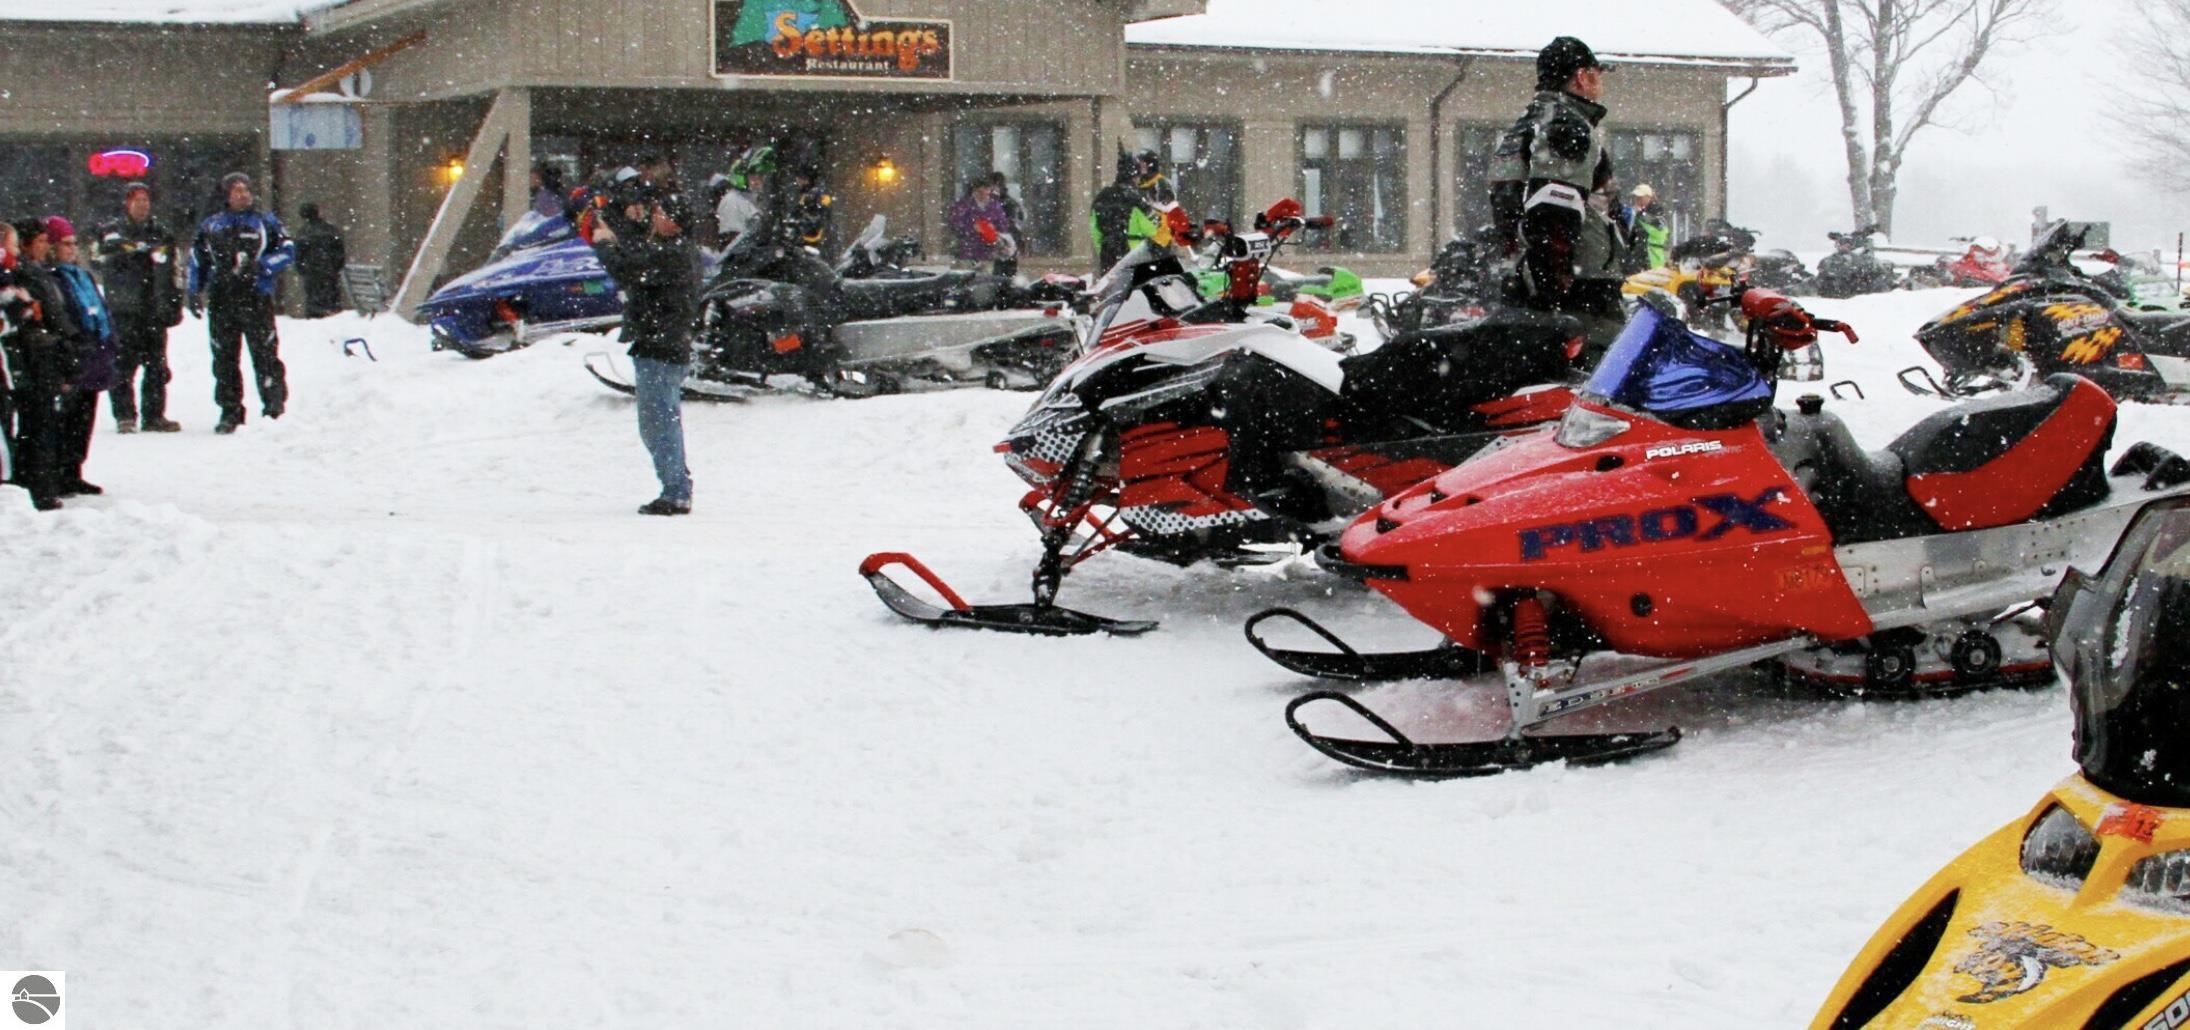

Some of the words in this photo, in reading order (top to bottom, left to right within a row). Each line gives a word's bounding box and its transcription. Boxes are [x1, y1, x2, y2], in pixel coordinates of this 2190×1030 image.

[772, 11, 939, 72] Settings
[805, 58, 890, 71] Restaurant
[1646, 440, 1723, 460] POLARIS
